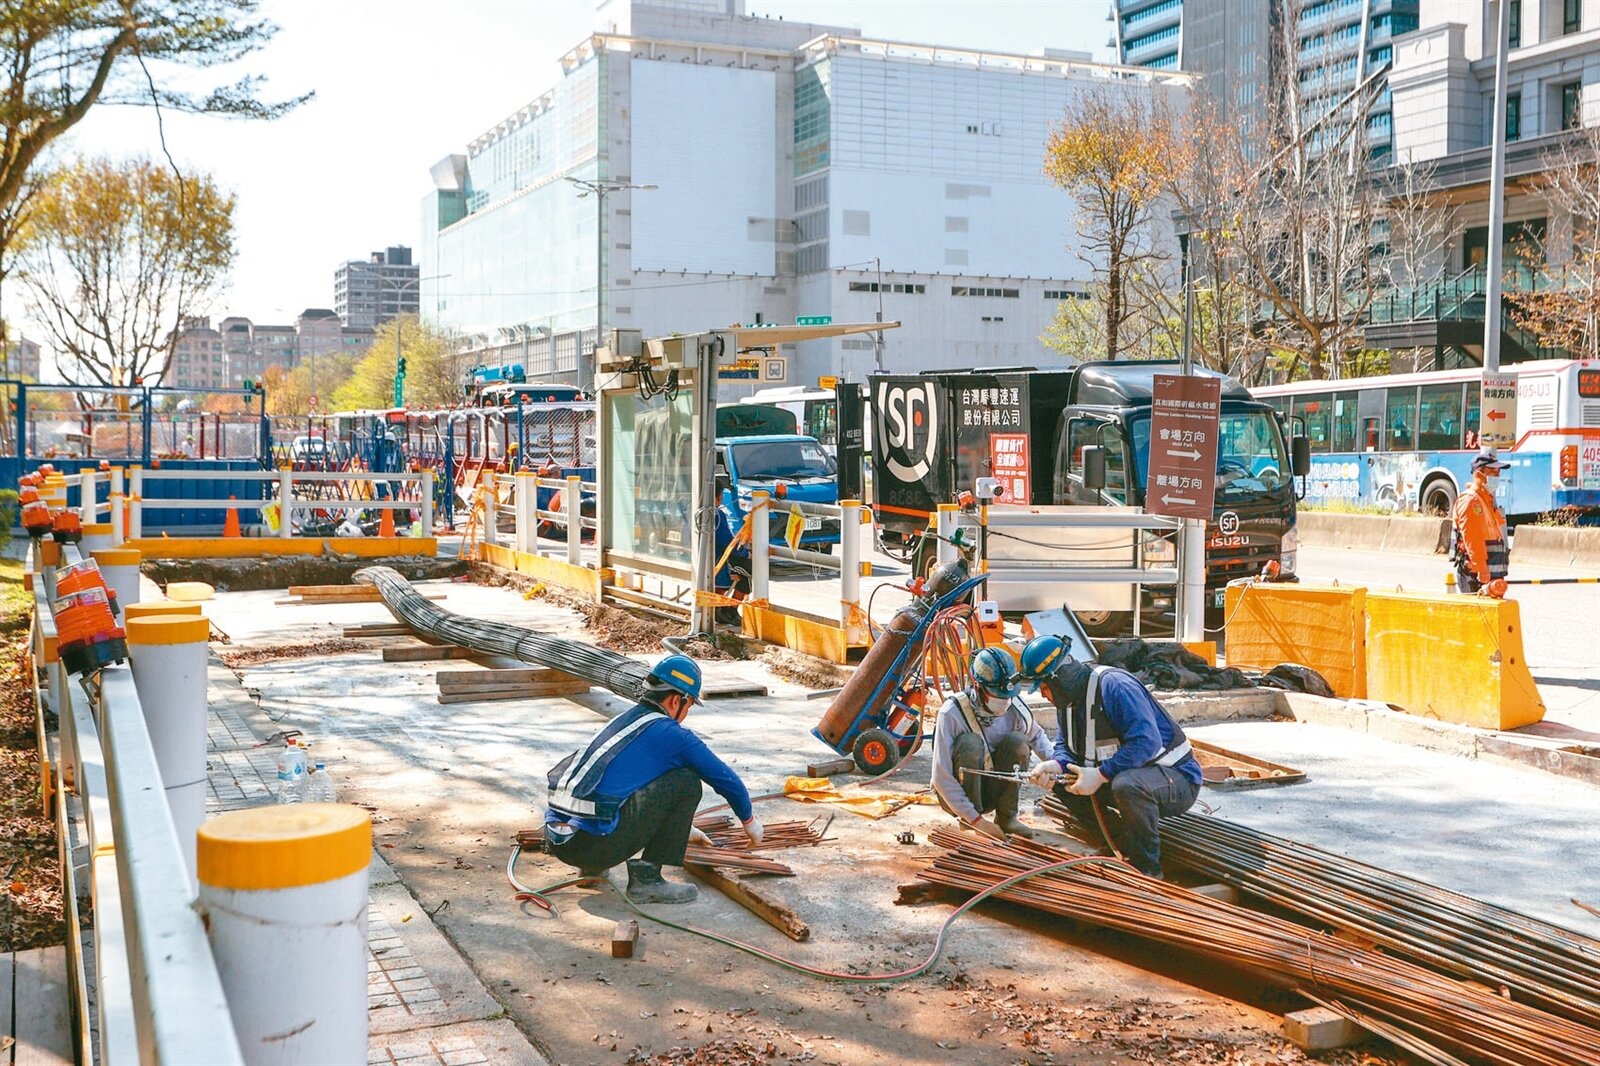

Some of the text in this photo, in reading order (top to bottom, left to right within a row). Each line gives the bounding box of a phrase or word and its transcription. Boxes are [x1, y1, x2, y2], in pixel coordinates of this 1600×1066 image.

[963, 409, 1021, 426] 股份有限公司
[1159, 428, 1205, 443] 會場方向
[1156, 474, 1203, 490] 離場方向
[1210, 535, 1250, 547] ISUZU
